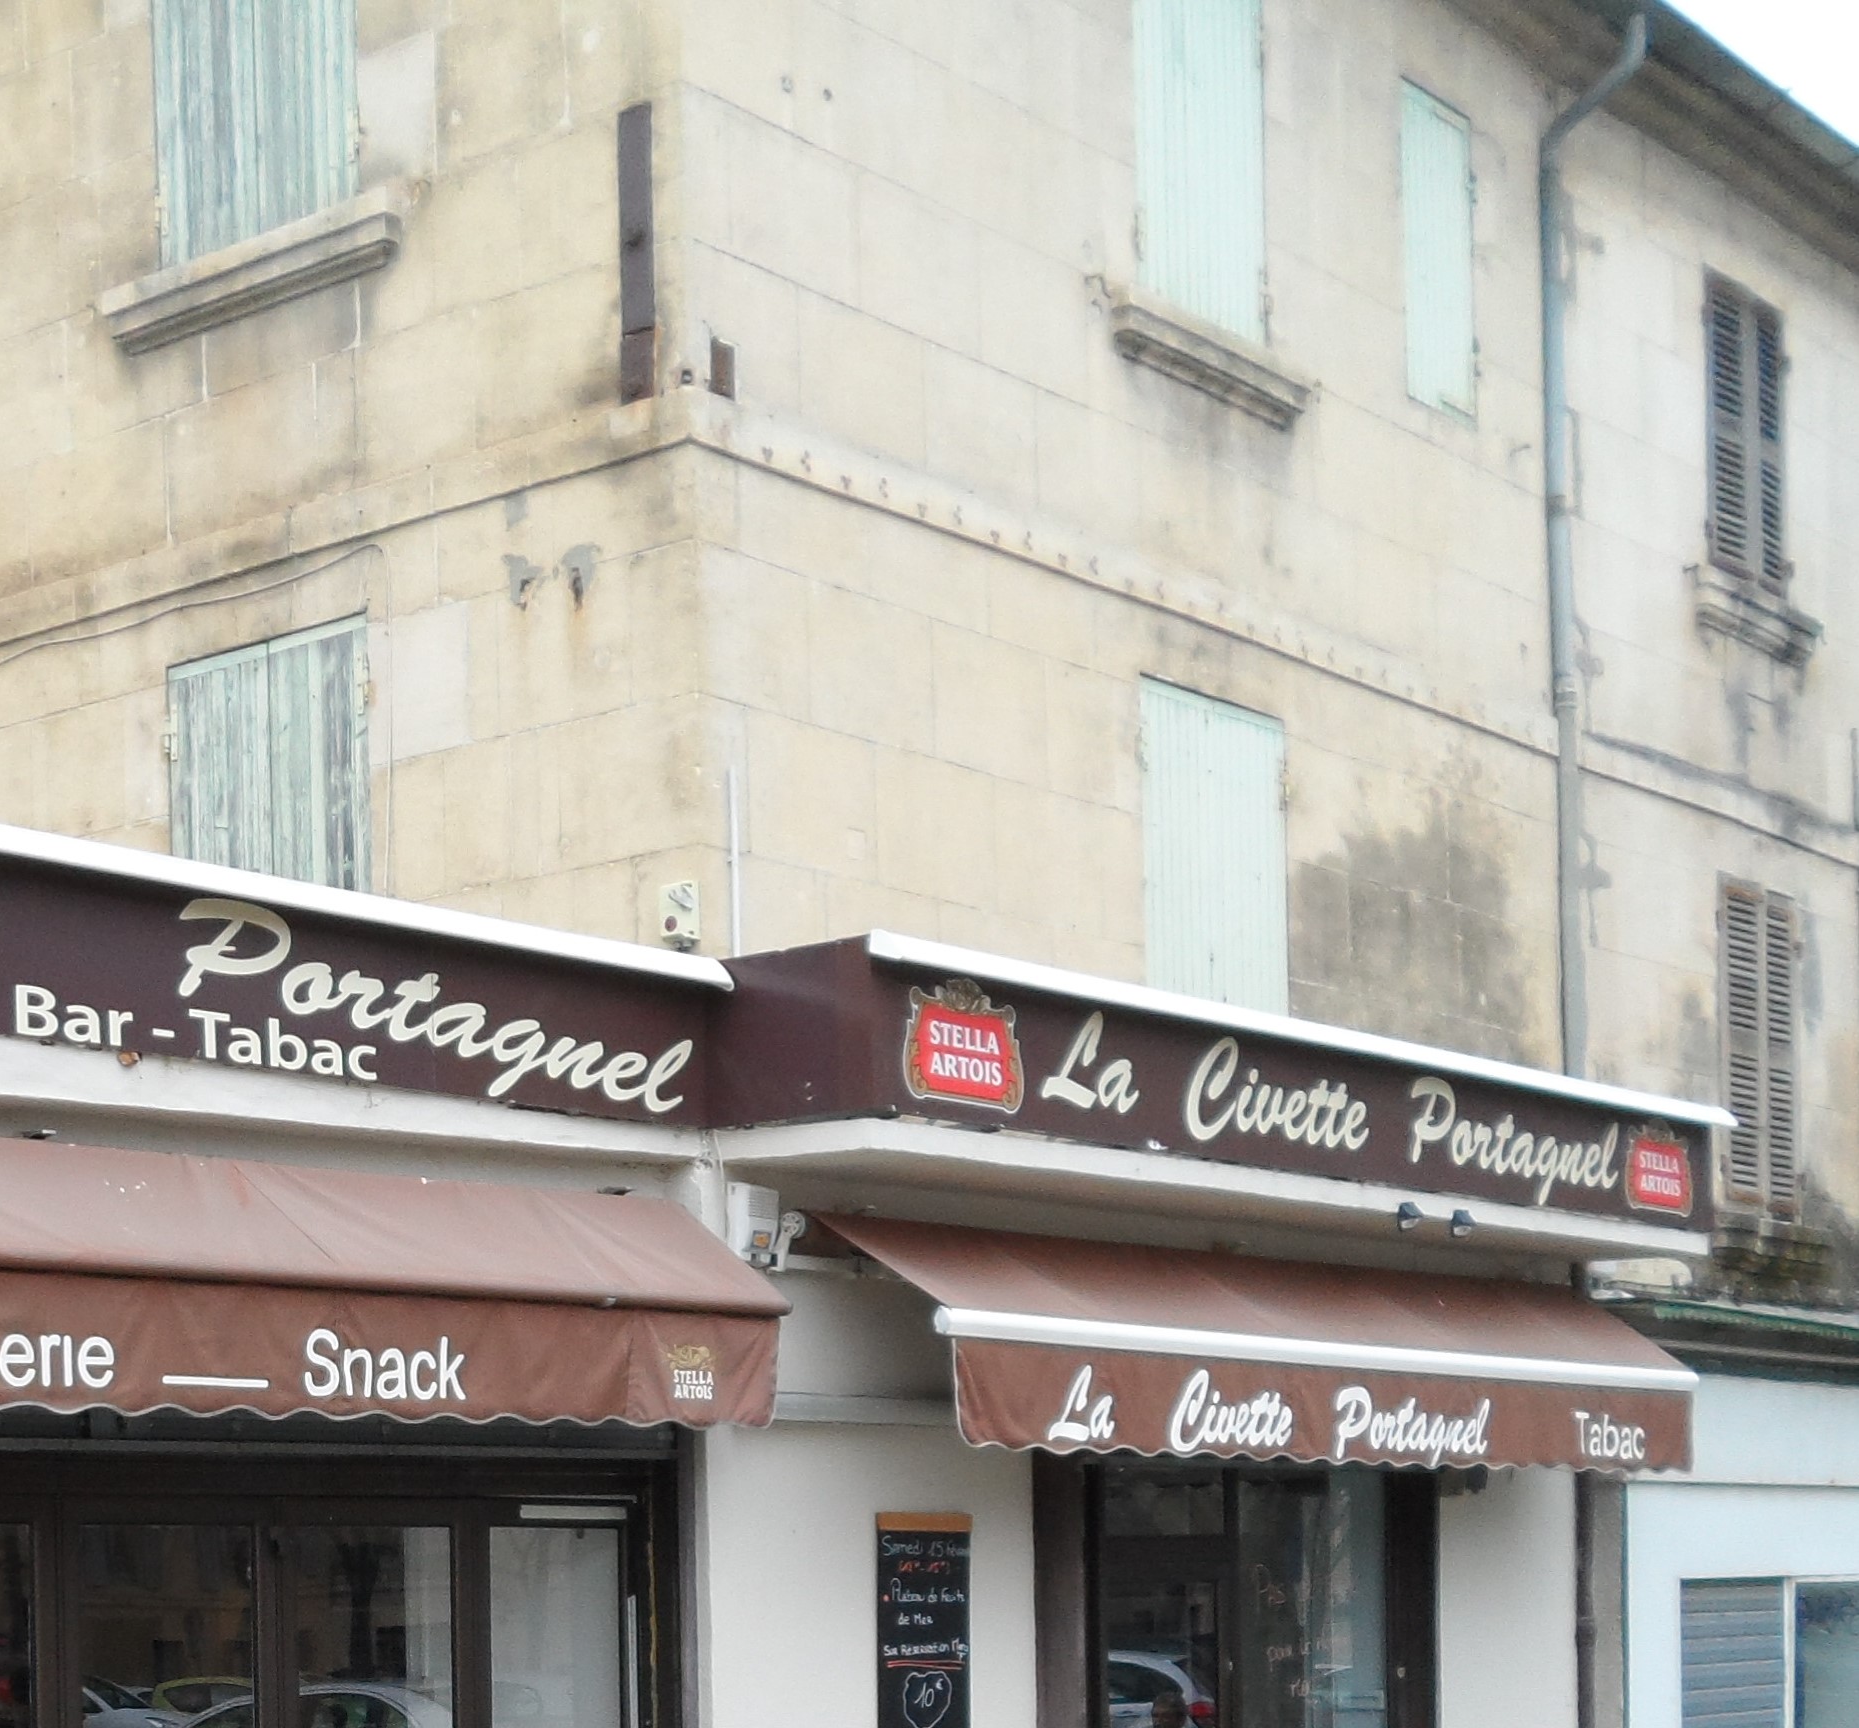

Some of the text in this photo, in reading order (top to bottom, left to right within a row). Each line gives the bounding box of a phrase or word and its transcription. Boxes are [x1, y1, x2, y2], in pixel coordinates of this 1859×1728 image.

[178, 899, 693, 1112] Portagnel
[14, 983, 133, 1047] Bar
[189, 1008, 378, 1081] Tabac
[929, 1020, 1000, 1055] STELLA
[930, 1052, 1003, 1086] ARTOIS
[1041, 1010, 1619, 1206] La Civette Portagnel
[1639, 1150, 1680, 1174] STELLA
[1641, 1174, 1682, 1197] ARTOIS
[304, 1328, 467, 1400] Snack
[673, 1369, 714, 1385] STELLA
[674, 1384, 713, 1400] ARTOIS
[1048, 1365, 1646, 1467] La Civette Portagnel Tabac
